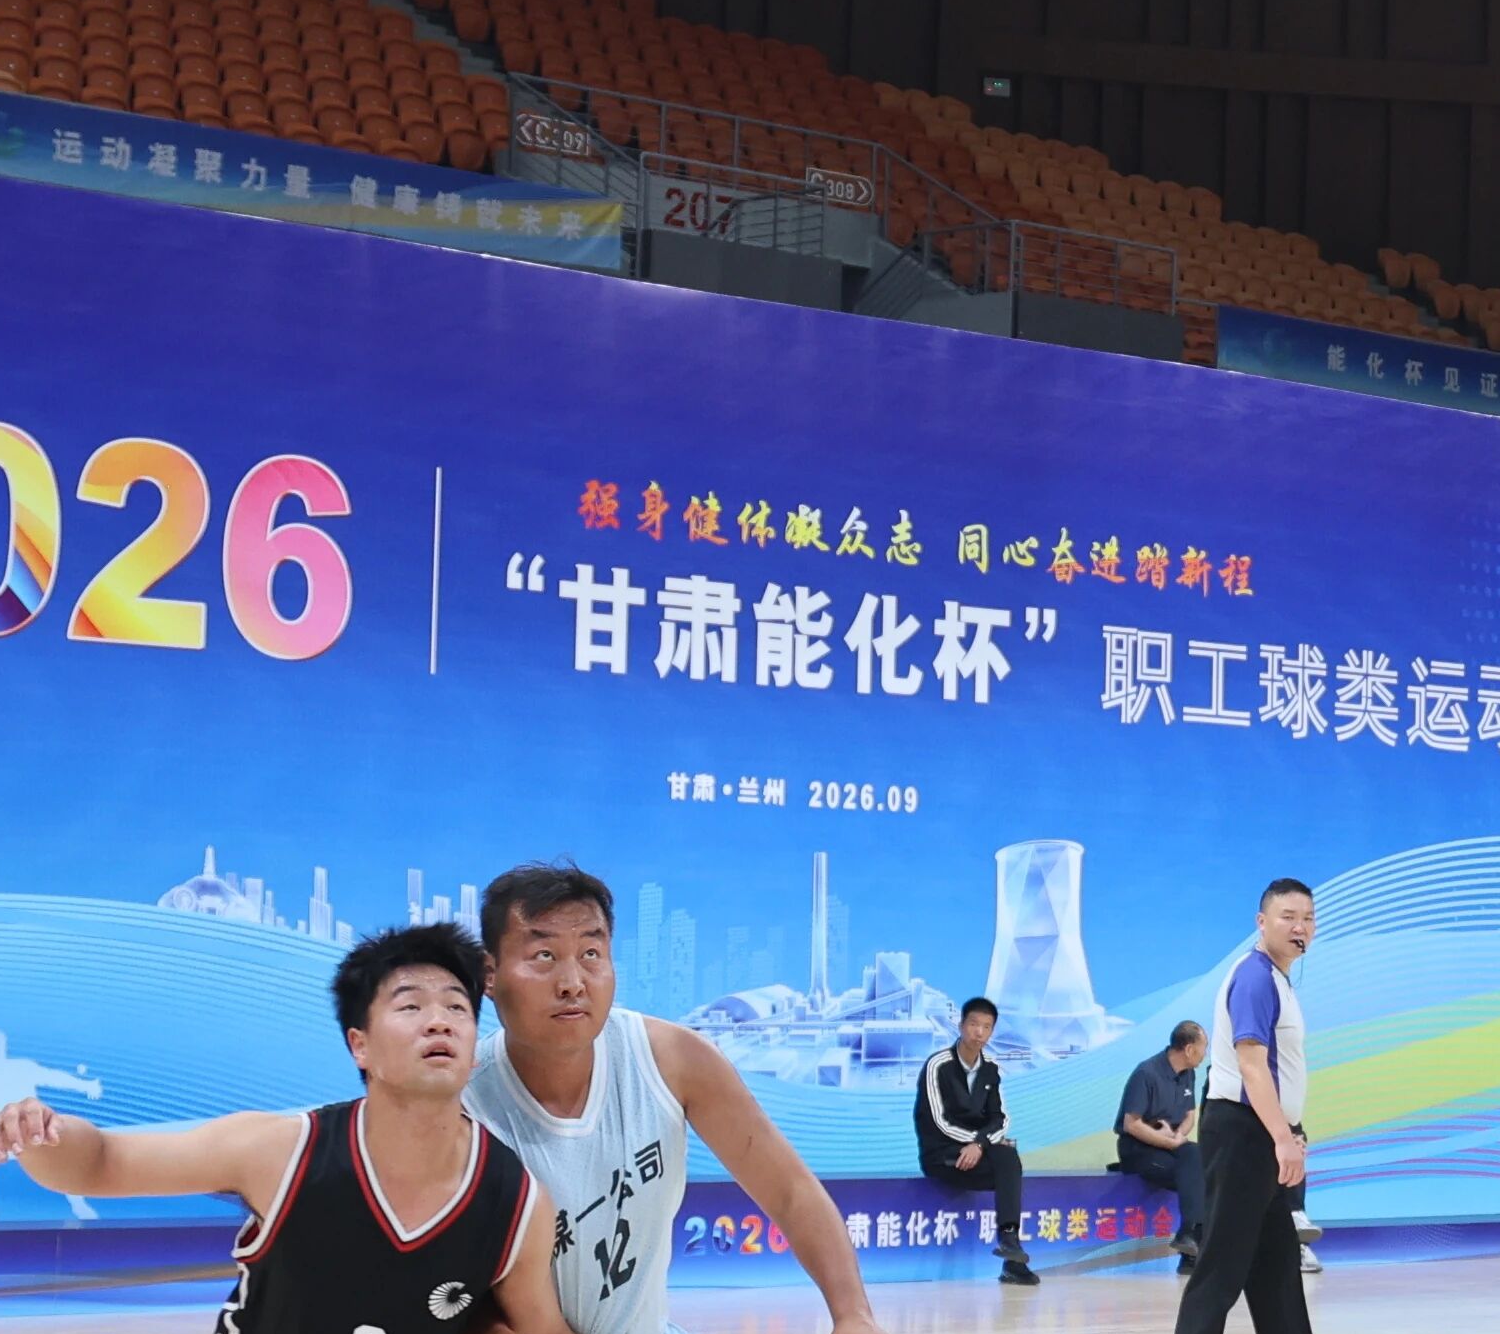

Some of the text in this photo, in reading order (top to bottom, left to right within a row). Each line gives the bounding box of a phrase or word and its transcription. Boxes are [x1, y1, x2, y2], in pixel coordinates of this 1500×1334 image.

[51, 127, 312, 200] 运动凝聚力量
[578, 478, 924, 566] 强身健体凝众志
[505, 552, 1059, 704] “甘肃能化杯”
[808, 780, 919, 814] 2026.09
[594, 1218, 637, 1302] 12
[683, 1214, 789, 1257] 2026
